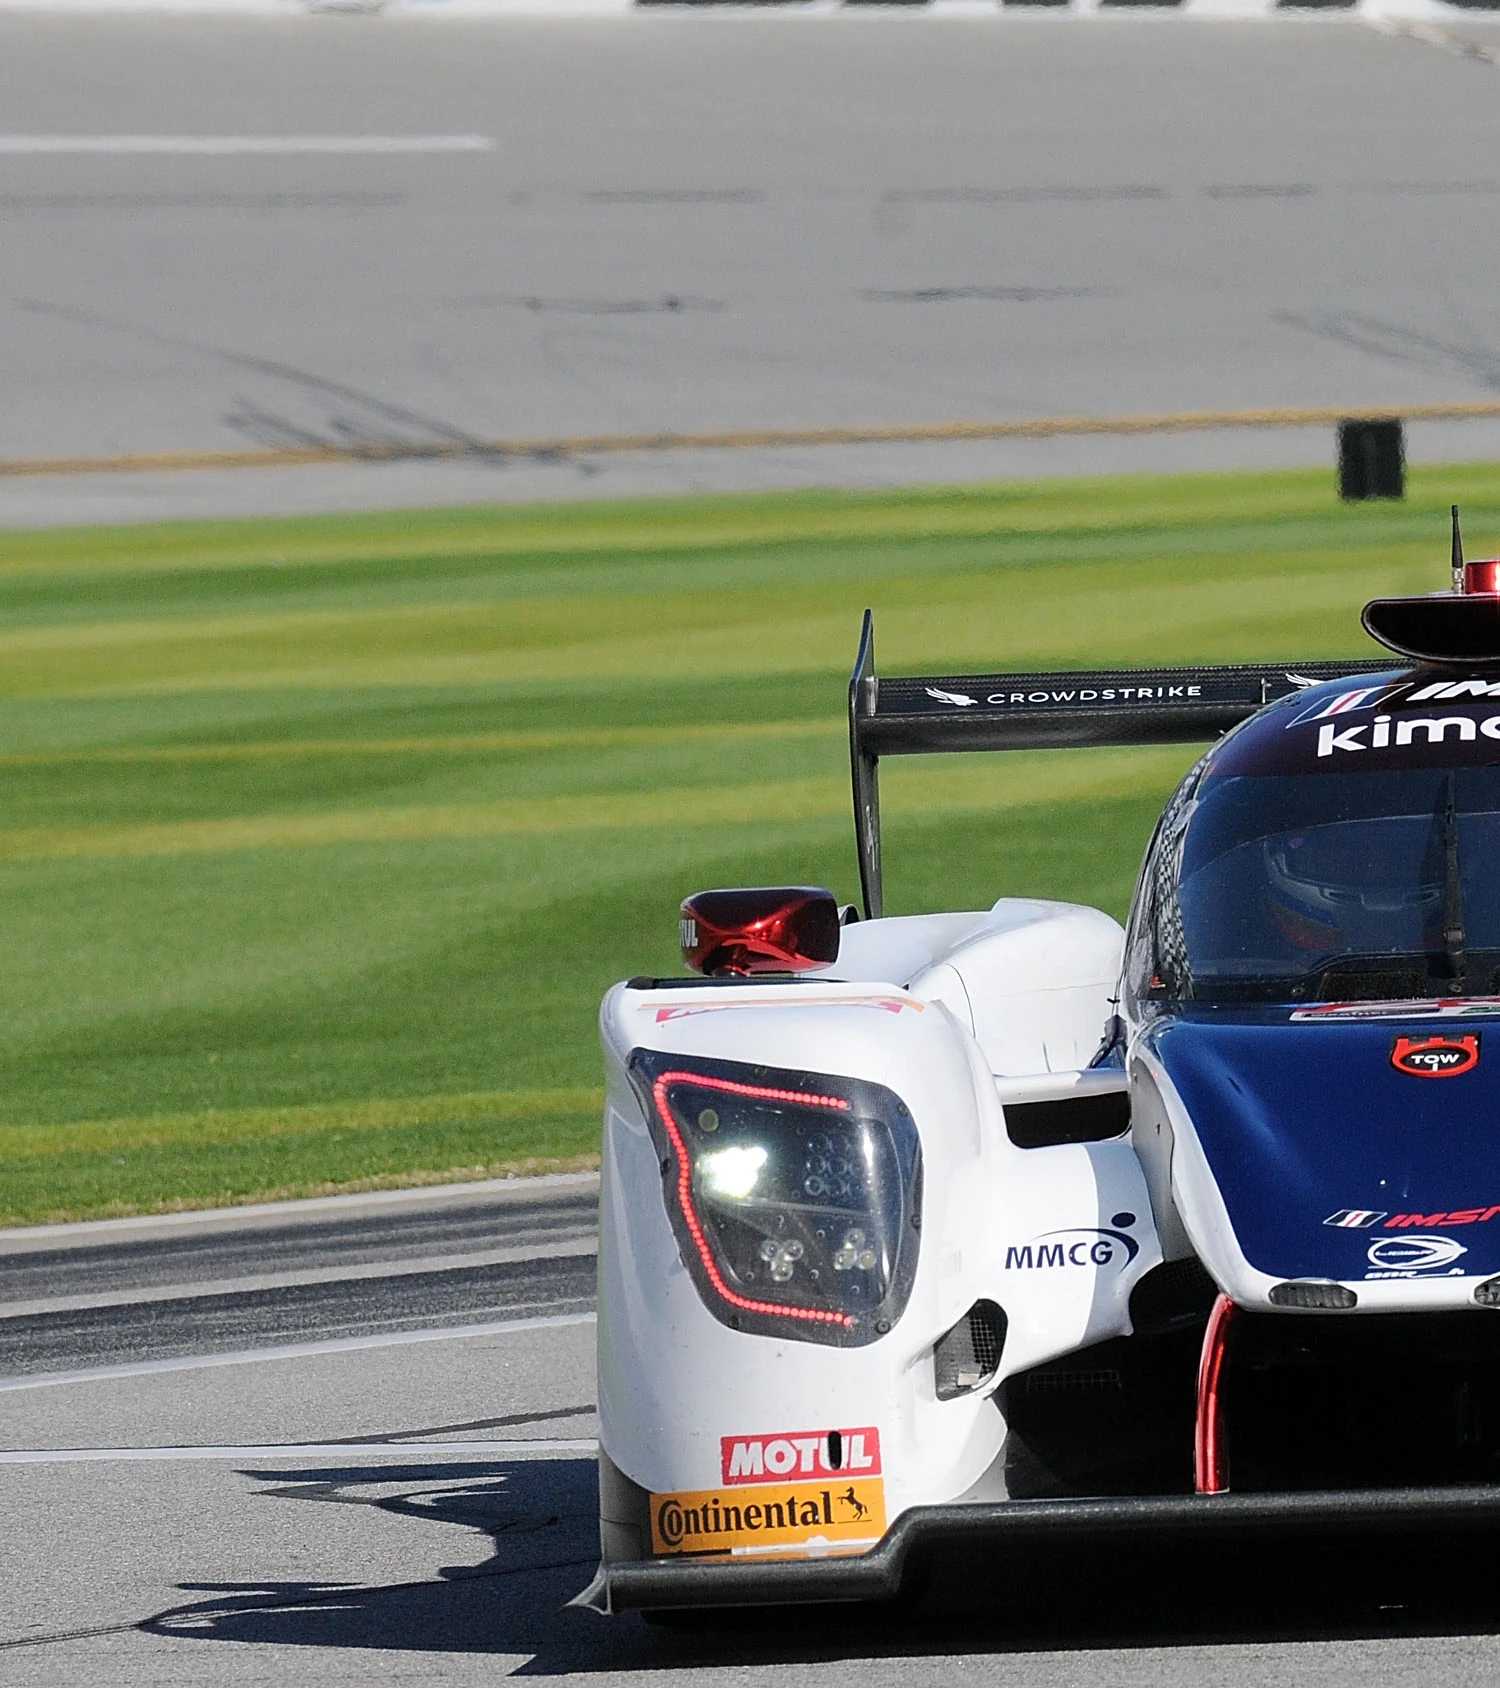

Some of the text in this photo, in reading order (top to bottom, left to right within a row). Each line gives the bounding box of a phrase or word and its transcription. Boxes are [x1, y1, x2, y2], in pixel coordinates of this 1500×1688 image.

[986, 685, 1202, 704] CROWDSTRIKE
[1411, 1053, 1459, 1067] TOW
[1004, 1240, 1113, 1269] MMCG
[728, 1433, 873, 1478] MOTUL
[658, 1491, 835, 1547] Continental
